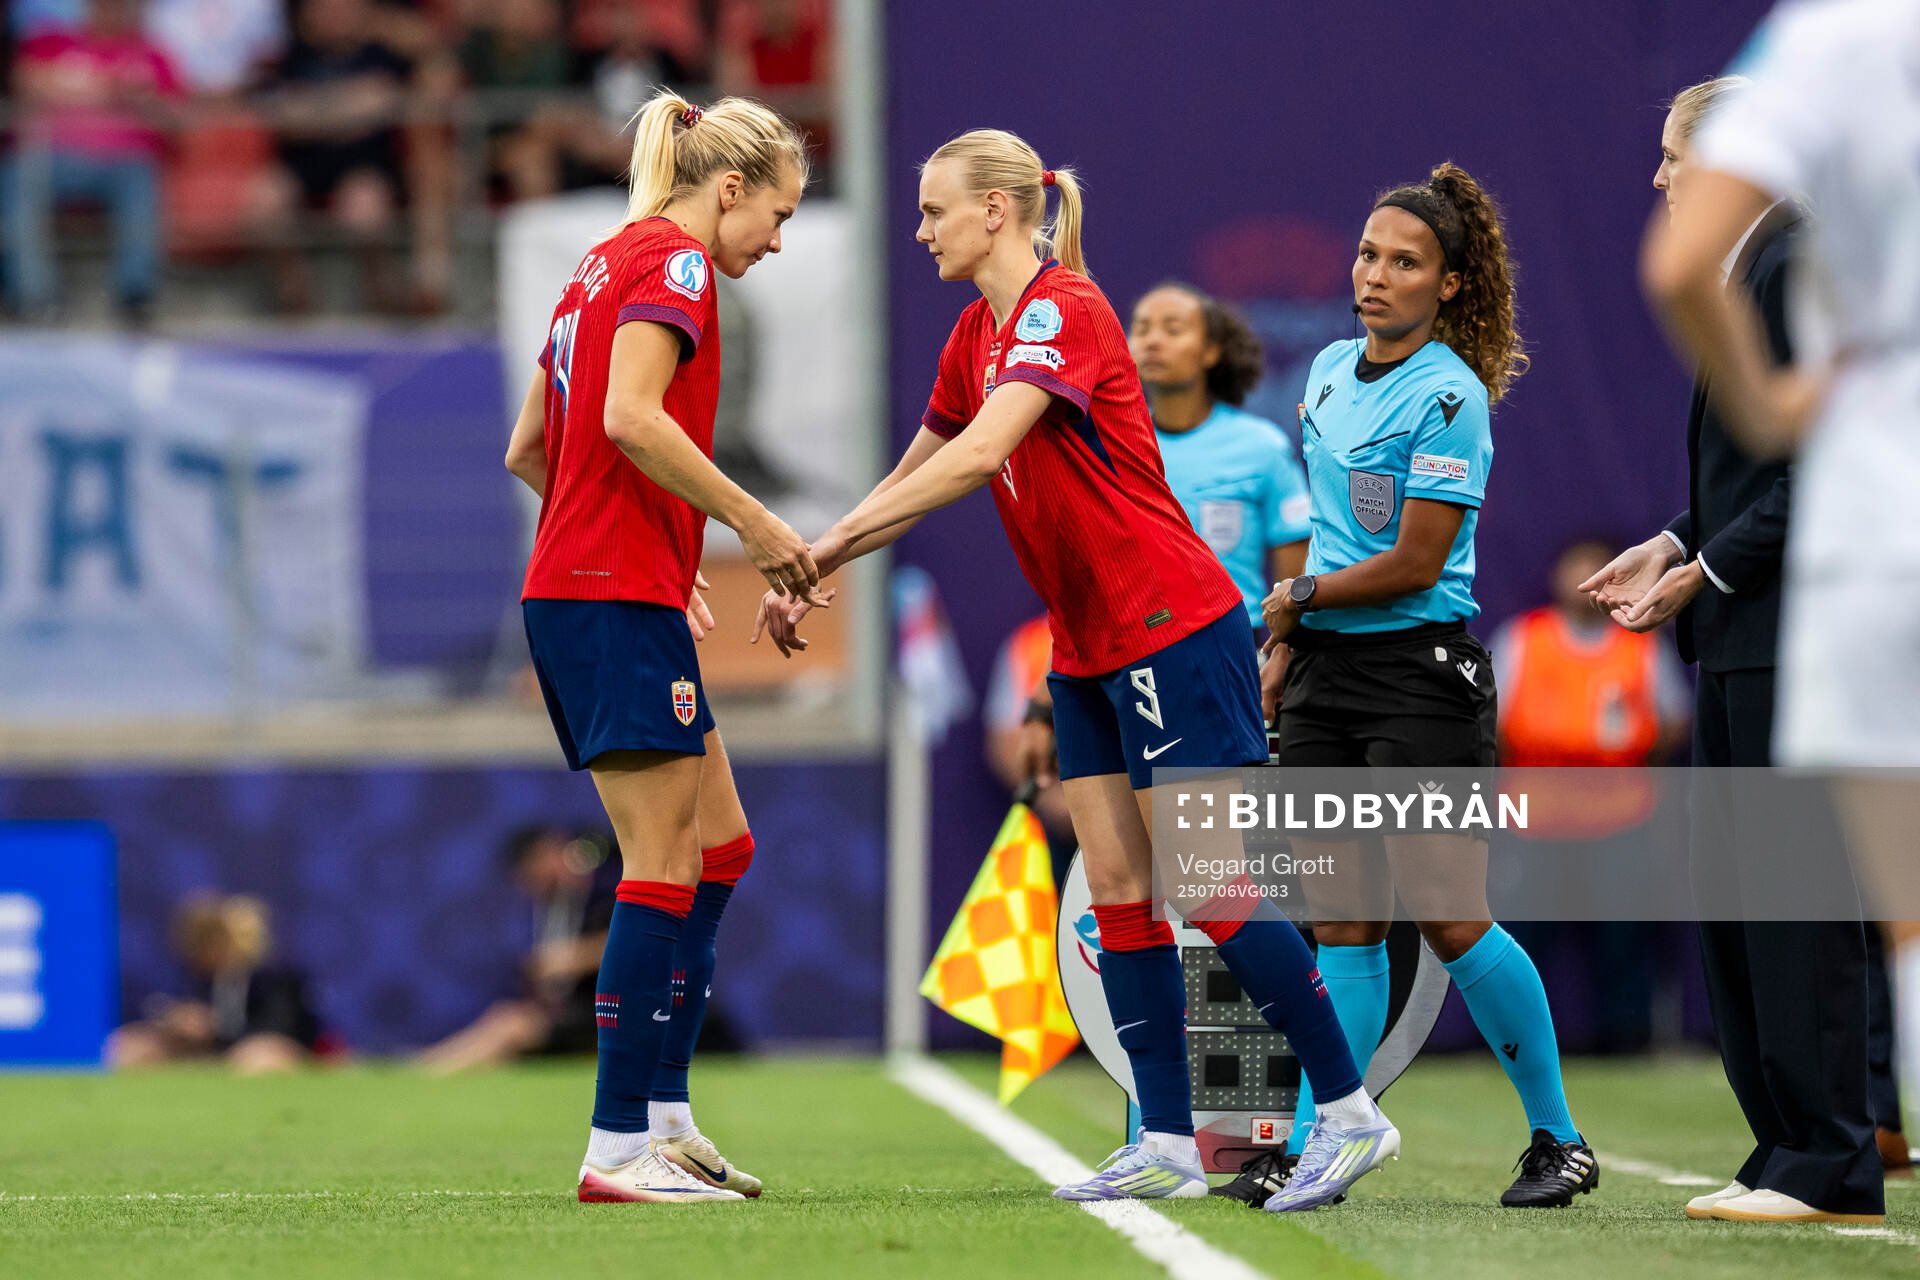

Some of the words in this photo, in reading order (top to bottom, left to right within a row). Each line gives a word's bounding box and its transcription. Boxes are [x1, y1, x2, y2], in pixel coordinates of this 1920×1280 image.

[1045, 350, 1059, 364] 10
[1413, 460, 1467, 474] FOUNDATION
[1357, 479, 1383, 493] UEFA
[1358, 497, 1385, 507] MATCH
[0, 427, 308, 608] AT
[1355, 506, 1388, 517] OFFICIAL
